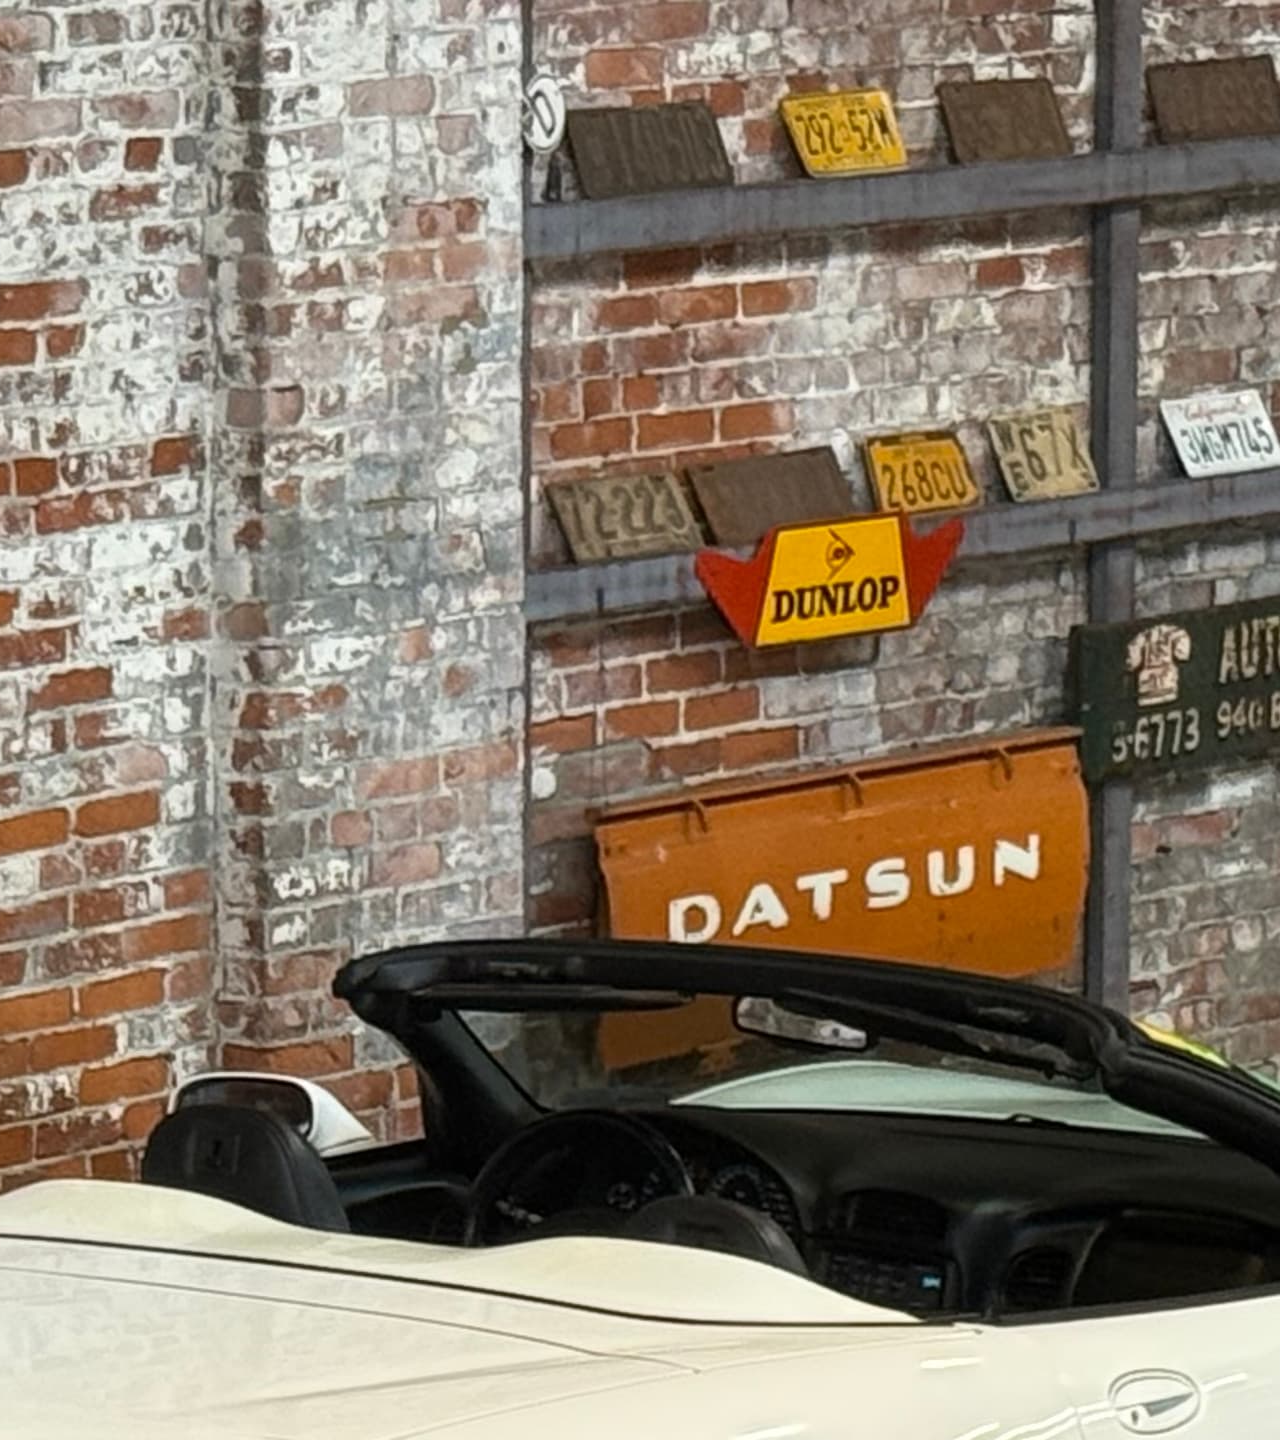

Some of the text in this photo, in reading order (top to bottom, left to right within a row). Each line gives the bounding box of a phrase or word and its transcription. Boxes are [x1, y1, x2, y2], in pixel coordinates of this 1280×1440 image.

[881, 459, 968, 508] 268CU
[771, 575, 900, 624] DUNLOP
[667, 834, 1041, 944] DATSUN
